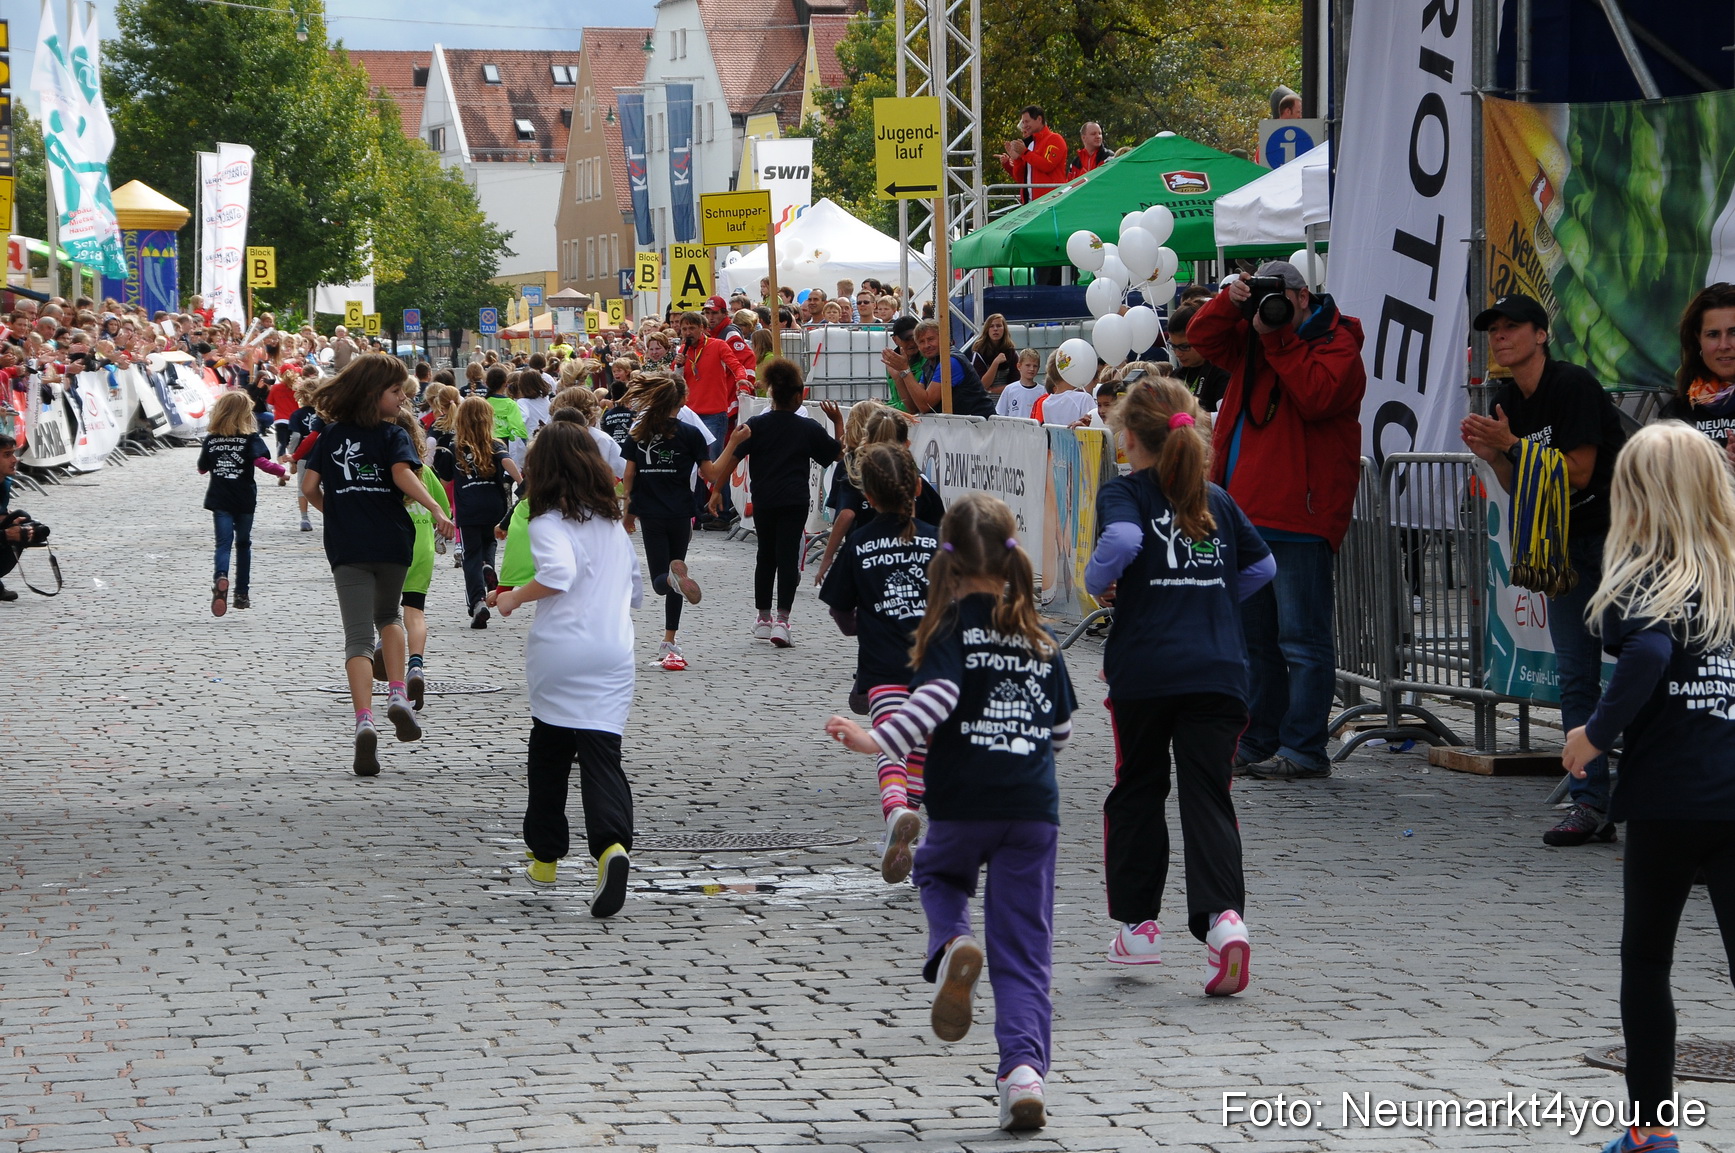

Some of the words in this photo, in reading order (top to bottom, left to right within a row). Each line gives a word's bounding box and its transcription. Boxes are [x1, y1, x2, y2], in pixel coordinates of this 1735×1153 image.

[877, 124, 939, 144] Jugend-
[895, 144, 923, 160] lauf
[763, 165, 810, 180] swn
[705, 206, 767, 219] Schnupper-
[726, 221, 747, 233] lauf
[249, 248, 271, 256] Block
[638, 253, 660, 262] Block
[674, 246, 710, 259] Block
[254, 259, 268, 279] B
[641, 263, 655, 283] B
[681, 264, 707, 297] A
[349, 308, 359, 321] C
[611, 307, 621, 320] C
[368, 319, 377, 330] D
[588, 318, 597, 329] D
[944, 452, 969, 488] BMW
[862, 552, 932, 569] STADTLAUF
[965, 652, 1052, 678] STADTLAUF
[1025, 675, 1053, 713] 2013
[960, 720, 1019, 735] BAMBINI
[1020, 722, 1051, 740] LAUF
